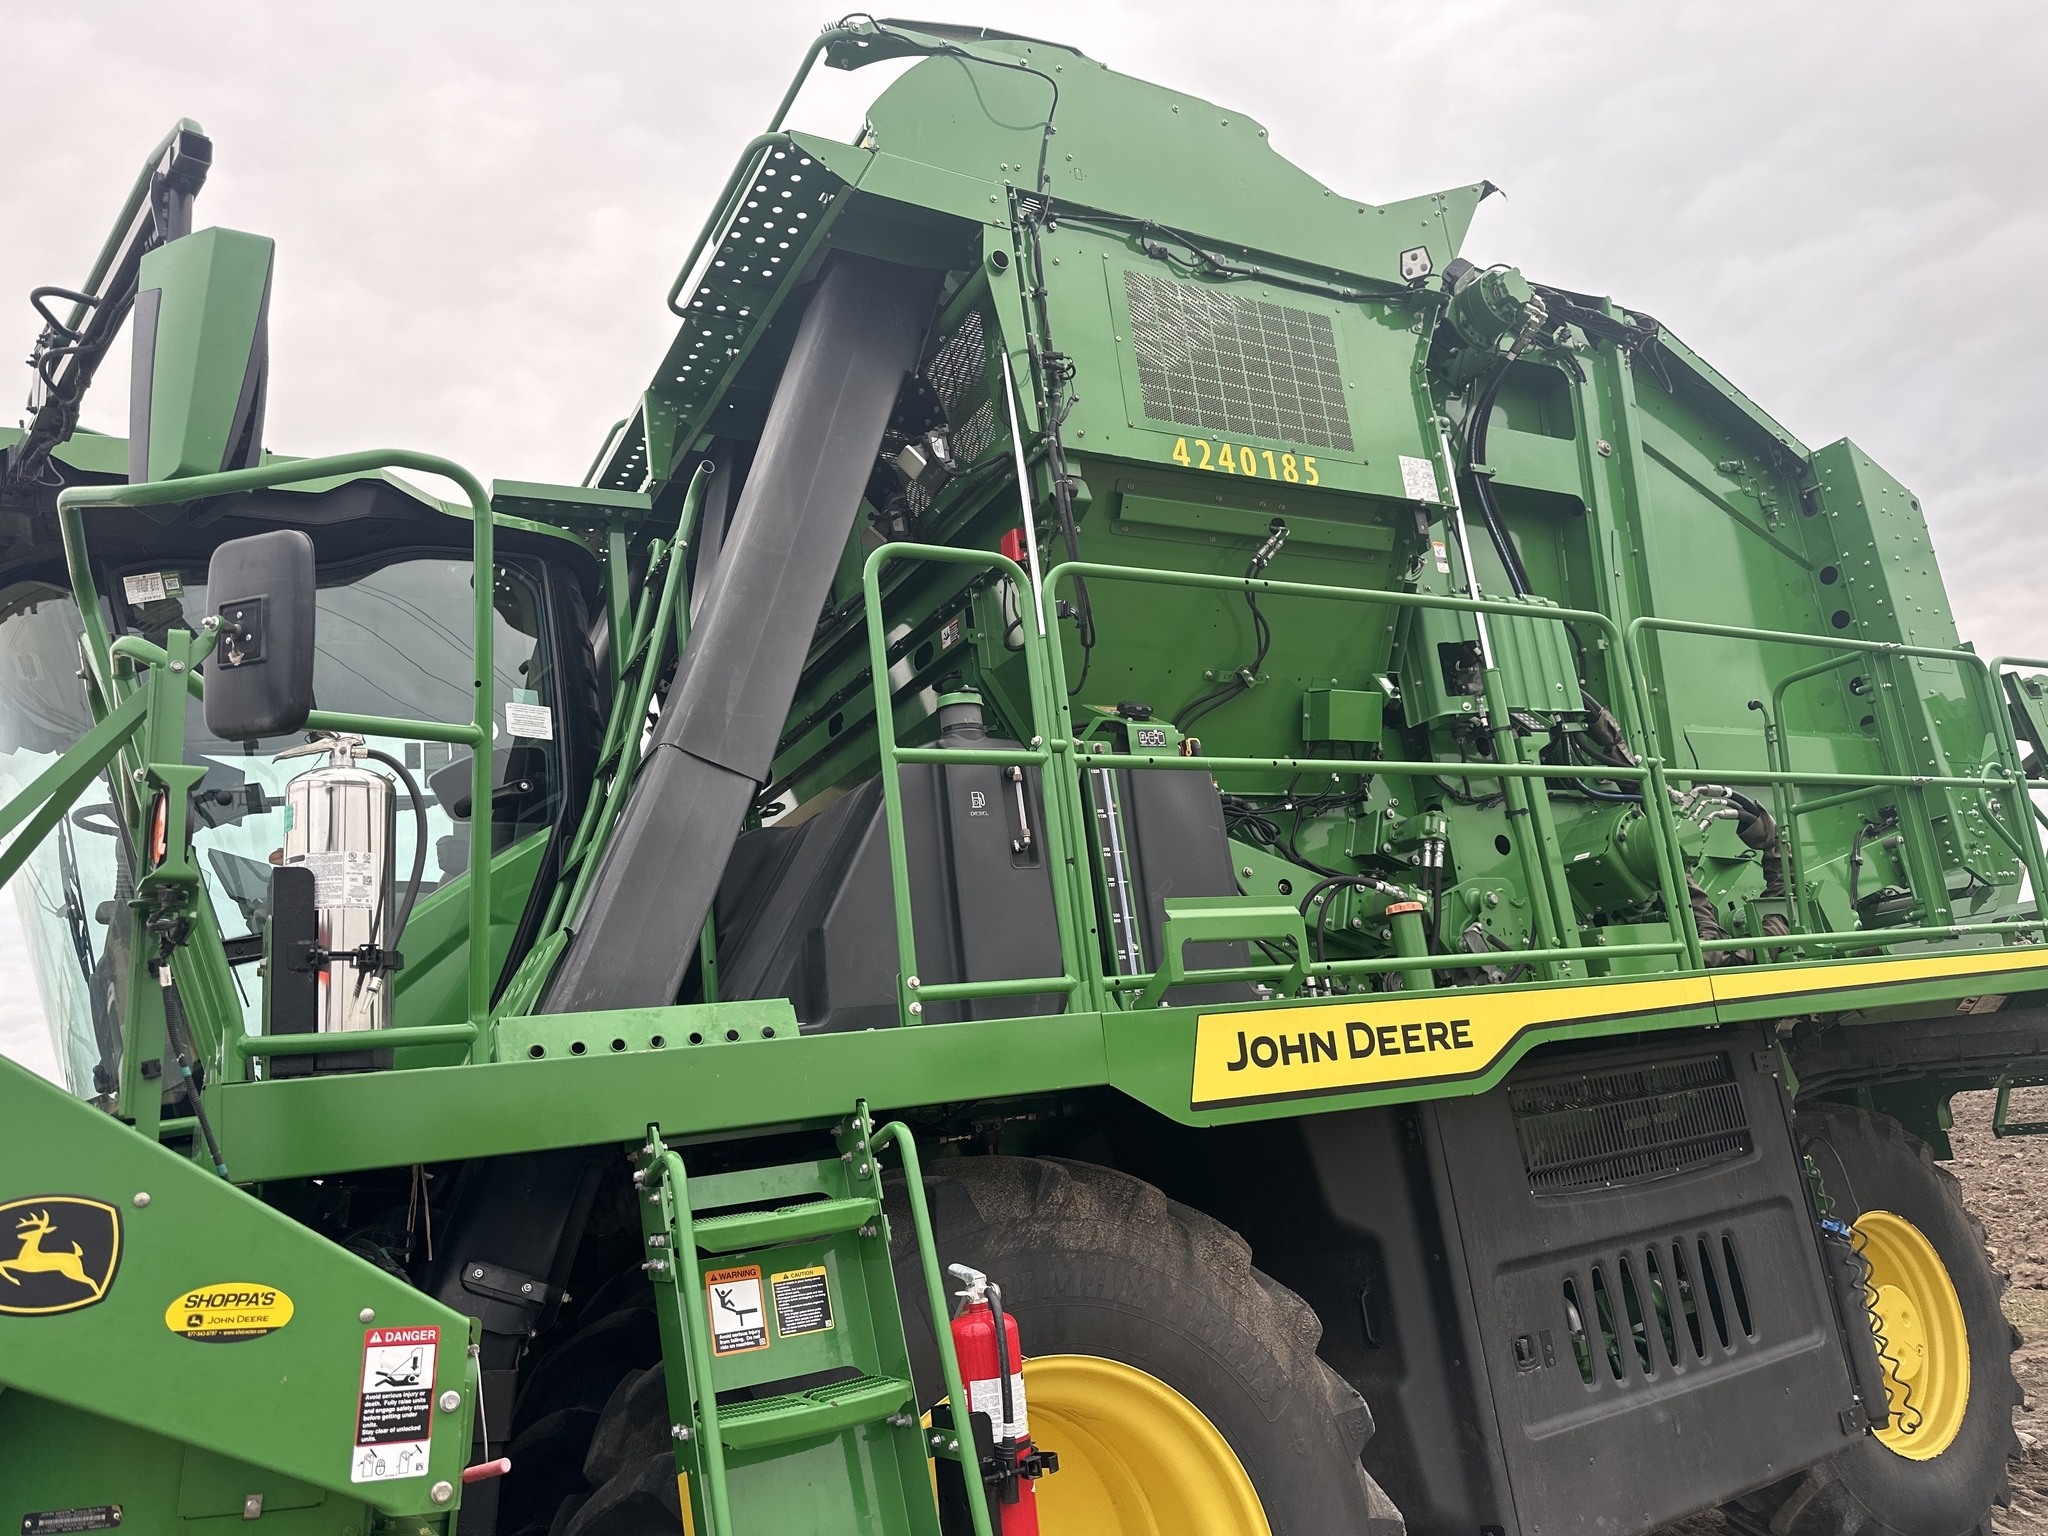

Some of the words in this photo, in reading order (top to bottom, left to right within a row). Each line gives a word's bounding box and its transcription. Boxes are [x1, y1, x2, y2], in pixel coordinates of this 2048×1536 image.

[1172, 437, 1320, 486] 4240185
[1227, 1030, 1339, 1072] JOHN
[1345, 1019, 1474, 1060] DEERE
[718, 1268, 757, 1280] WARNING
[790, 1269, 814, 1279] CAUTION
[184, 1292, 276, 1309] SHOPPA'S
[207, 1316, 235, 1325] JOHN
[237, 1315, 269, 1323] DEERE
[385, 1329, 436, 1343] DANGER
[403, 1391, 419, 1399] injury
[375, 1407, 395, 1415] engage
[396, 1405, 413, 1413] safety
[381, 1413, 401, 1422] getting
[396, 1425, 421, 1433] unlocked
